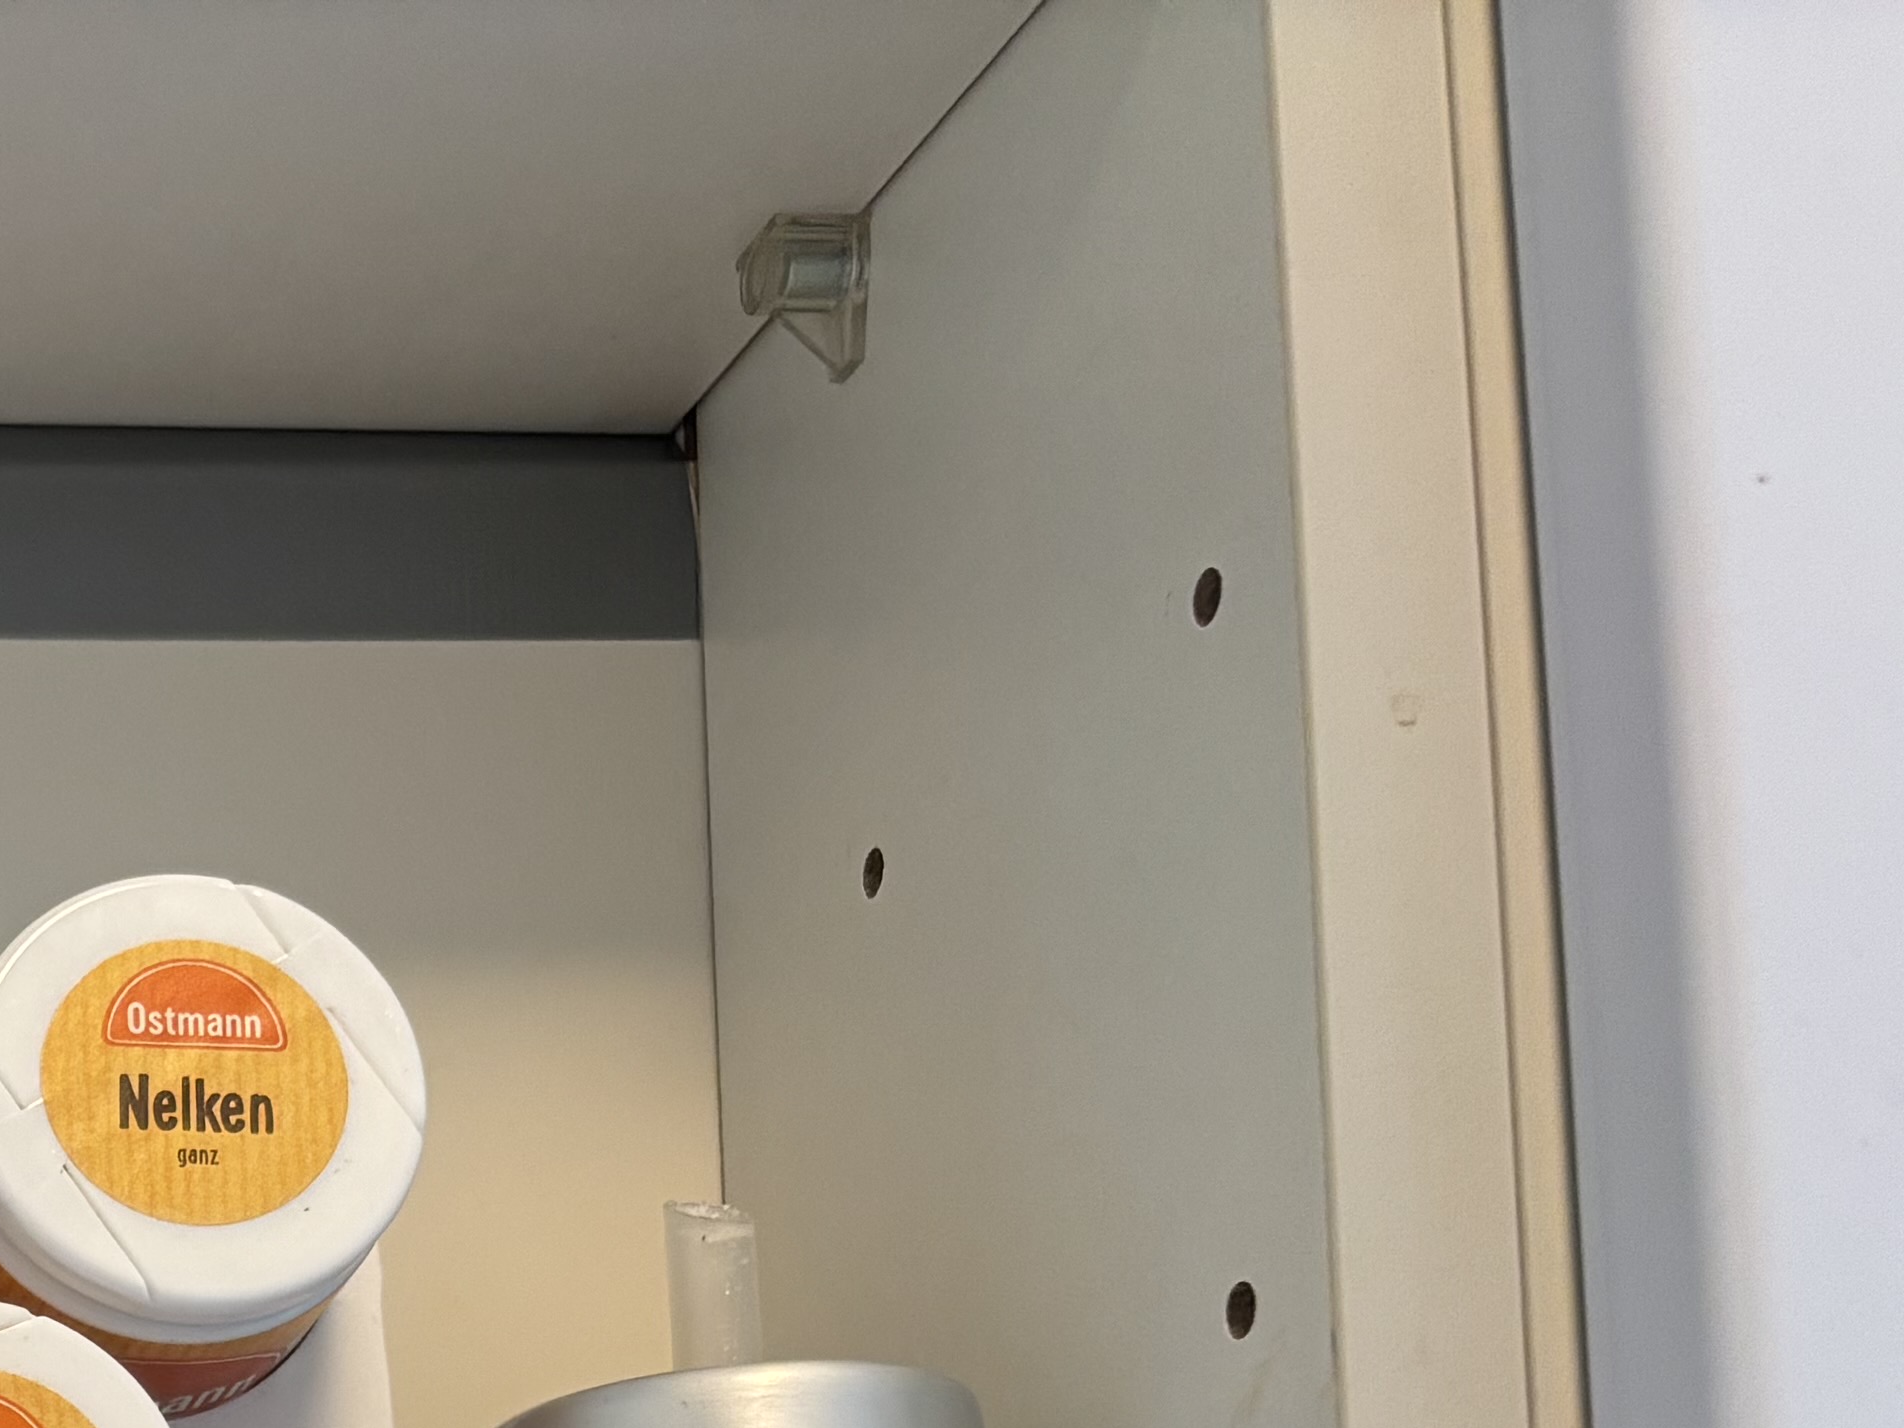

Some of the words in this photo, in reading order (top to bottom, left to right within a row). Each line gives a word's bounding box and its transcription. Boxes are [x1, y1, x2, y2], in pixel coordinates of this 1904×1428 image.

[126, 1003, 262, 1040] Ostmann
[118, 1074, 275, 1135] Nelken
[177, 1146, 220, 1168] ganz
